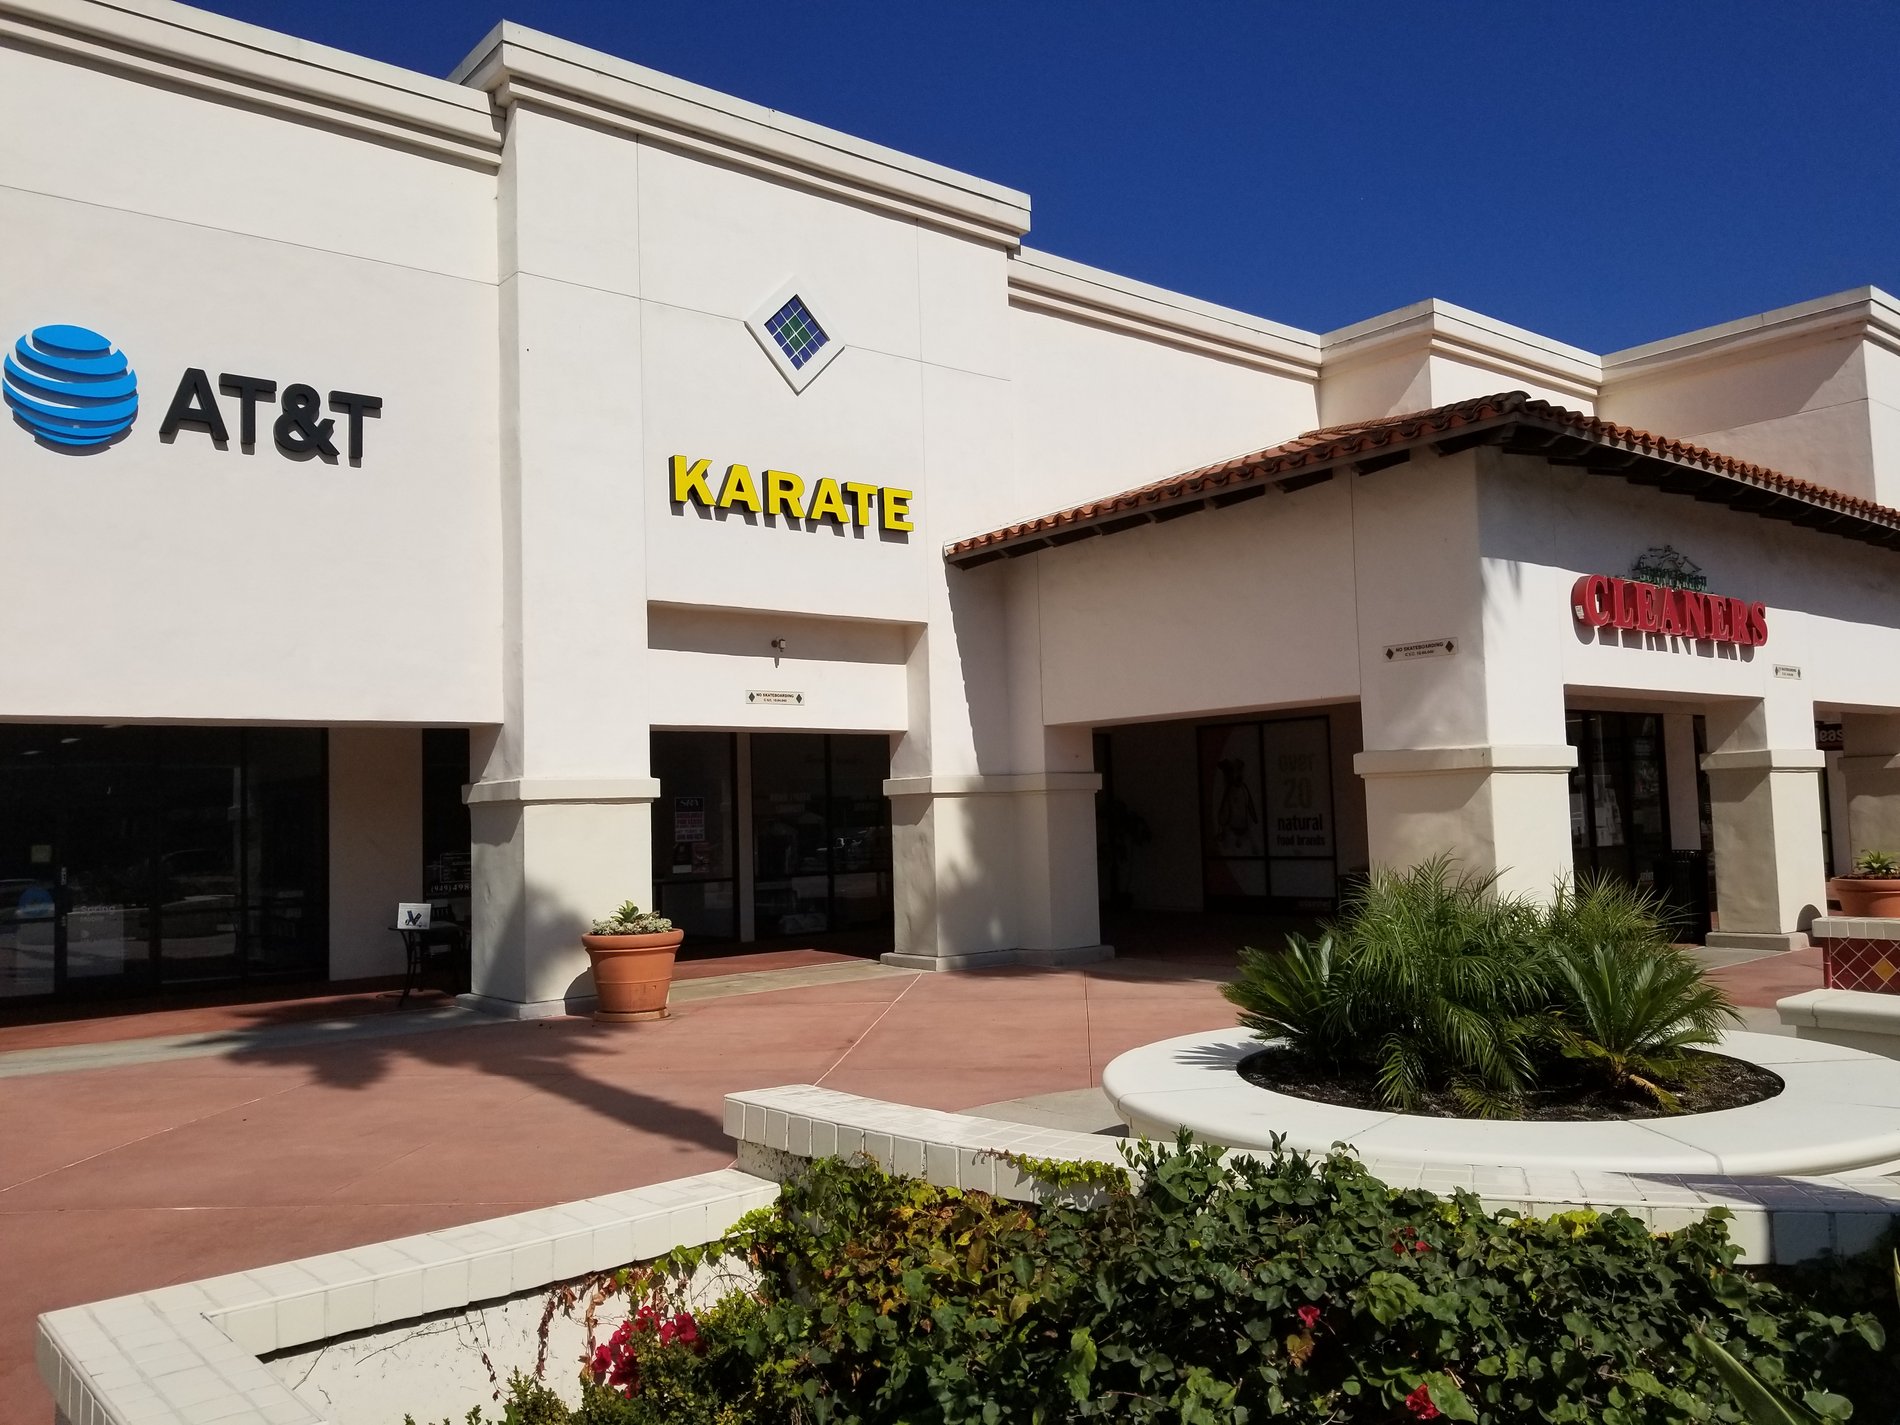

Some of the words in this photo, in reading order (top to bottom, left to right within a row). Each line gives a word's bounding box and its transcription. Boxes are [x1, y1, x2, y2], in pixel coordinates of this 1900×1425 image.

[159, 367, 383, 459] AT&T
[669, 454, 914, 533] KARATE
[1571, 574, 1768, 647] CLEANERS
[1283, 777, 1313, 808] 20
[1277, 835, 1294, 846] food
[1297, 835, 1325, 846] brands
[1278, 814, 1322, 831] natural
